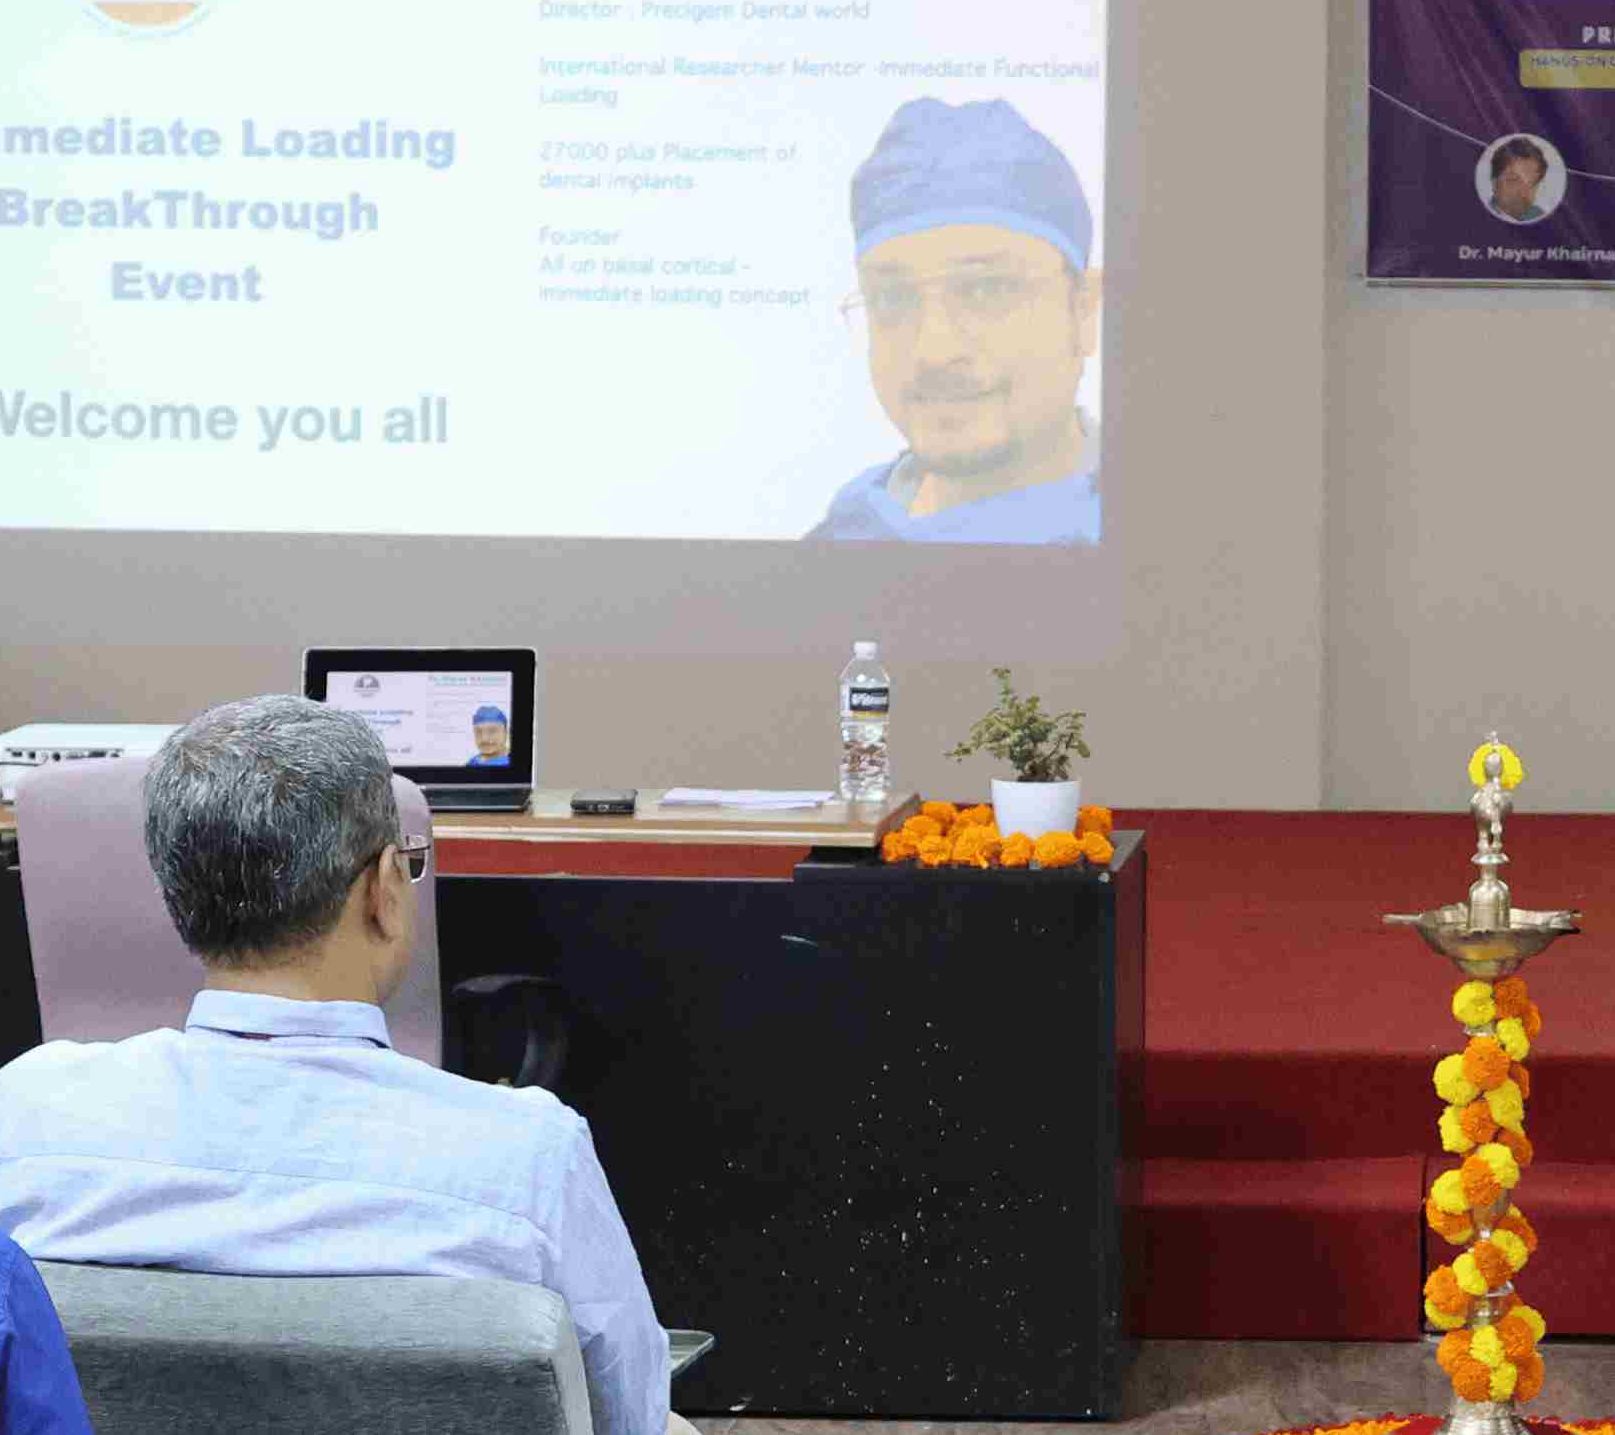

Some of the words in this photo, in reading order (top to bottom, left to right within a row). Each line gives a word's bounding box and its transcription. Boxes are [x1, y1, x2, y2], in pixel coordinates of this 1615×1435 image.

[540, 0, 621, 20] Director
[741, 0, 808, 21] Dental
[814, 0, 871, 21] world
[540, 57, 666, 79] International
[672, 58, 787, 79] Researcher
[792, 58, 867, 79] Mentor
[993, 59, 1100, 80] Functional
[539, 83, 617, 108] Loading
[241, 118, 457, 171] Loading
[616, 142, 656, 167] plus
[663, 141, 769, 163] Placement
[776, 142, 798, 163] of
[540, 170, 602, 191] dental
[607, 170, 695, 198] implants
[539, 227, 622, 248] Founder
[604, 255, 655, 276] basal
[660, 256, 739, 277] cortical
[1459, 246, 1483, 260] Dr.
[1487, 246, 1543, 264] Mayur
[110, 262, 264, 303] Event
[649, 283, 723, 310] loading
[728, 286, 811, 310] concept
[255, 405, 363, 453] you
[380, 396, 450, 445] all
